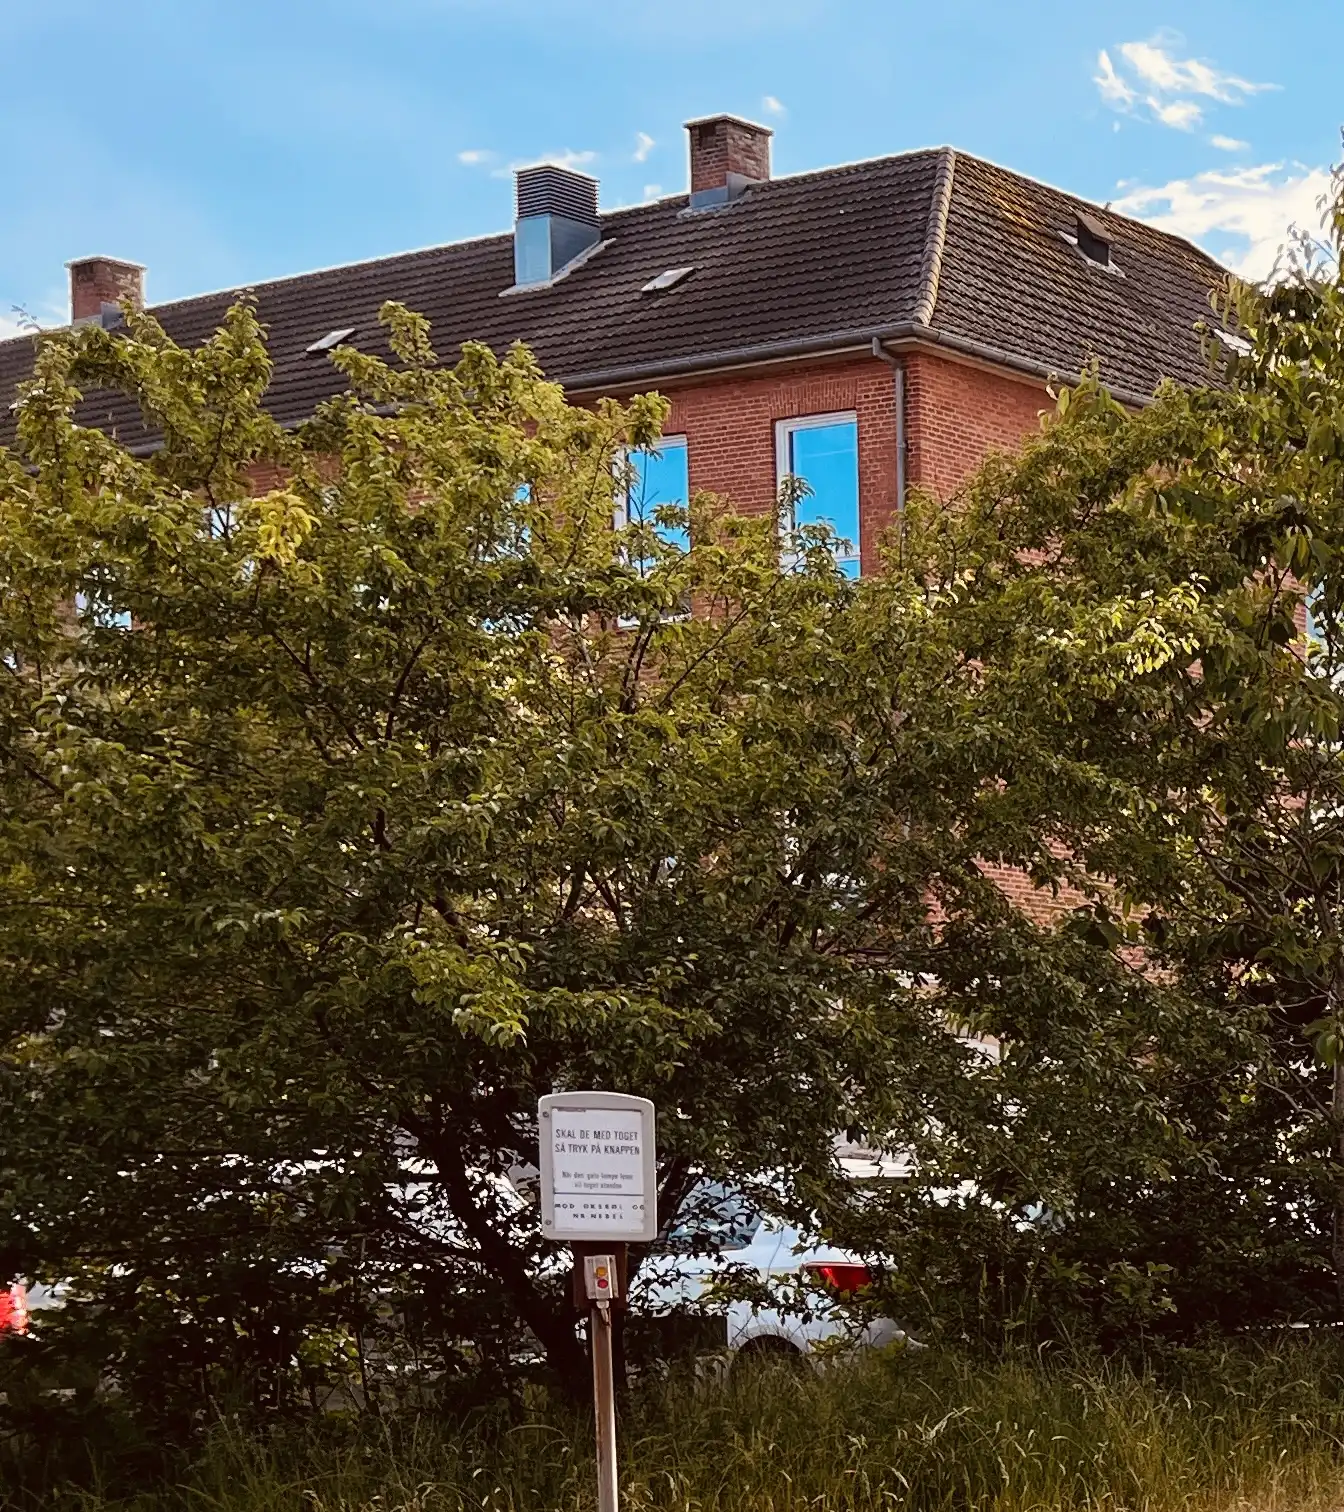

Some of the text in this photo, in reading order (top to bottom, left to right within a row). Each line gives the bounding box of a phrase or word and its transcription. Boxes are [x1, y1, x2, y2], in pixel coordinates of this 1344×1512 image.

[556, 1129, 638, 1141] SKAL DE MED TOGET
[555, 1142, 640, 1155] SÅ TRYK PÅ KNAPPEN
